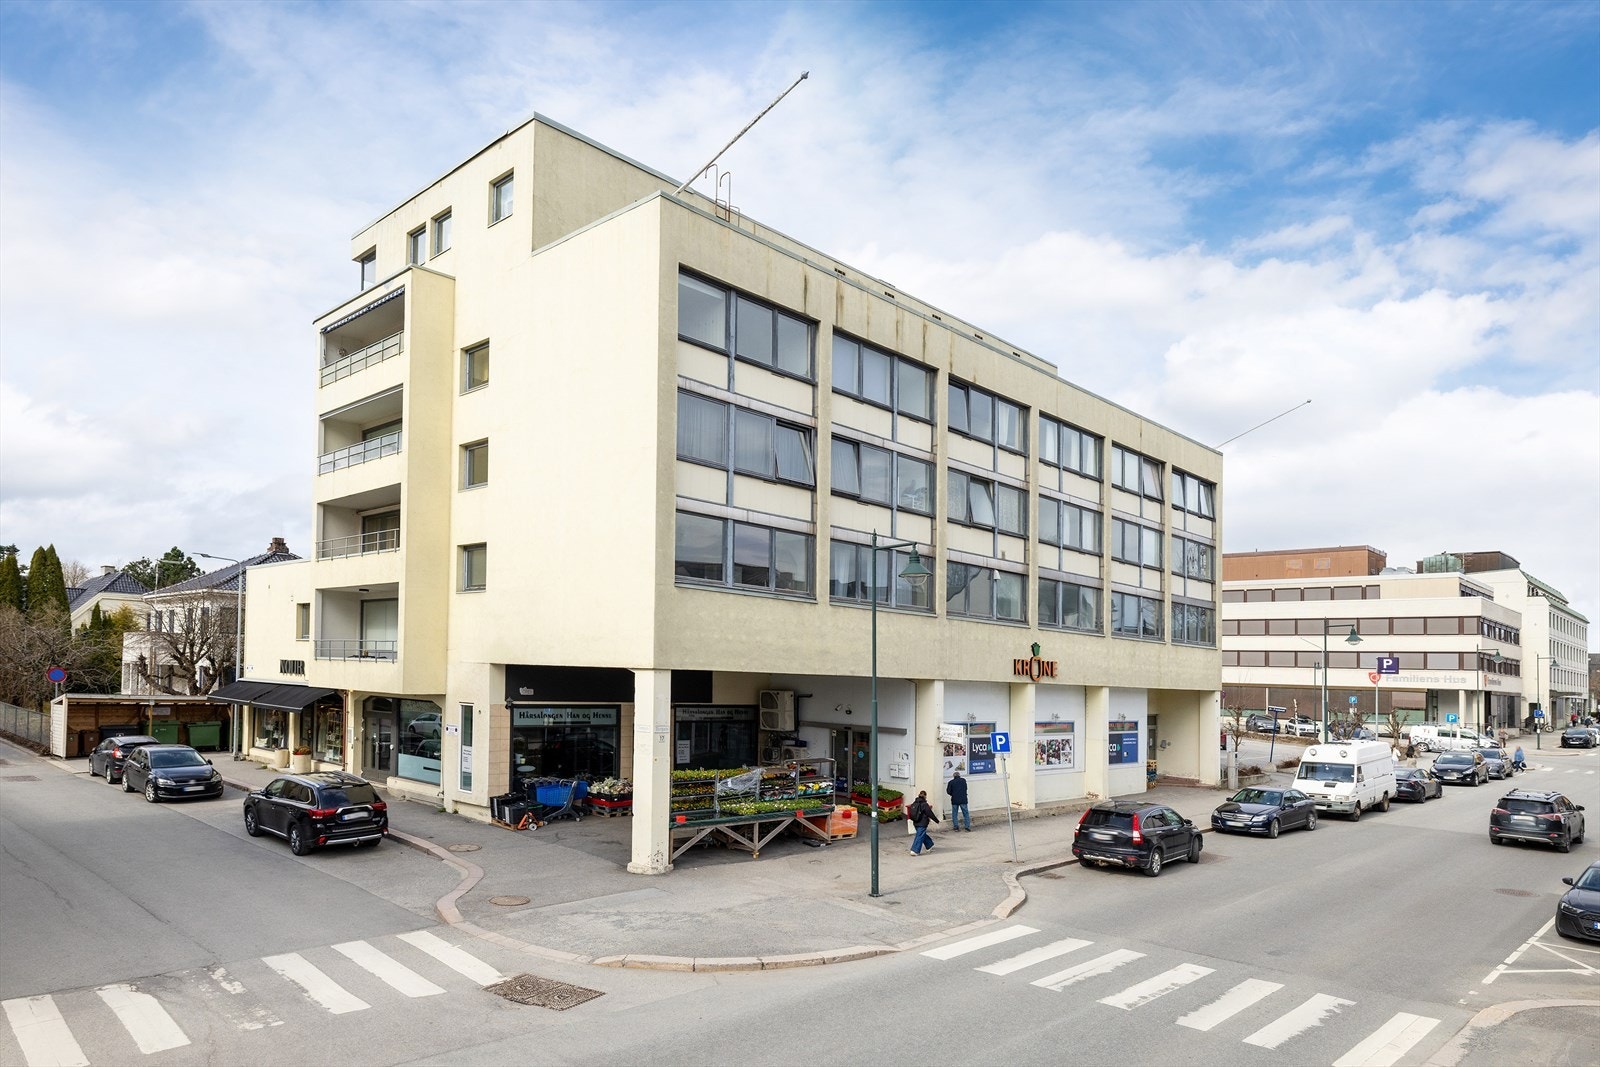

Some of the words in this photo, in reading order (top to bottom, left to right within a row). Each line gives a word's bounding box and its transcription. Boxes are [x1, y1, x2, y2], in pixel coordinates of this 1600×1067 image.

[1013, 656, 1057, 681] KRONE
[1383, 659, 1393, 669] P
[1386, 674, 1440, 683] Familiens
[1443, 675, 1467, 684] Hus
[1448, 714, 1456, 722] P
[995, 735, 1006, 750] P
[972, 743, 987, 753] Lyca
